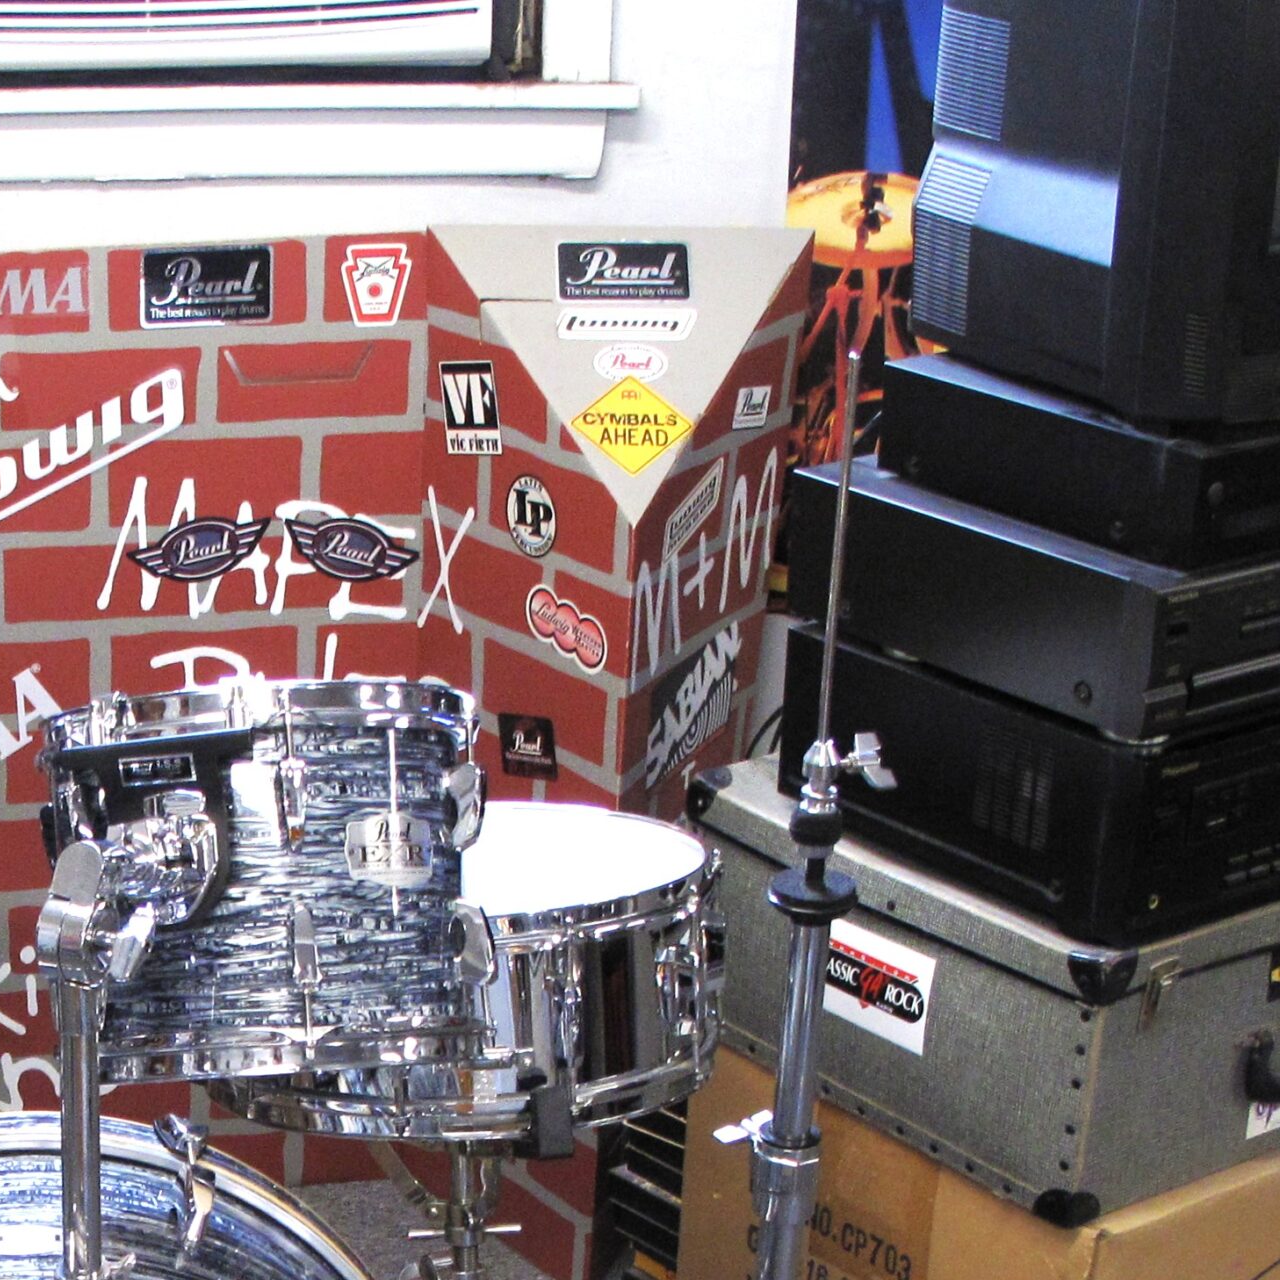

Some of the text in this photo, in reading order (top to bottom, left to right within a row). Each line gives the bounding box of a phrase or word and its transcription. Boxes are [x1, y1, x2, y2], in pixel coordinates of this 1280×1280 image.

[151, 256, 260, 306] Pearl
[567, 246, 676, 285] Pearl
[442, 372, 494, 425] VF
[582, 412, 679, 427] CYMBALS
[600, 427, 669, 447] AHEAD
[513, 487, 553, 540] LP
[173, 530, 231, 567] Pearl
[322, 530, 383, 566] Pearl
[535, 602, 570, 636] Ludwig
[645, 620, 742, 789] SABIAN
[512, 730, 542, 752] Pearl
[884, 983, 924, 1016] ROCK
